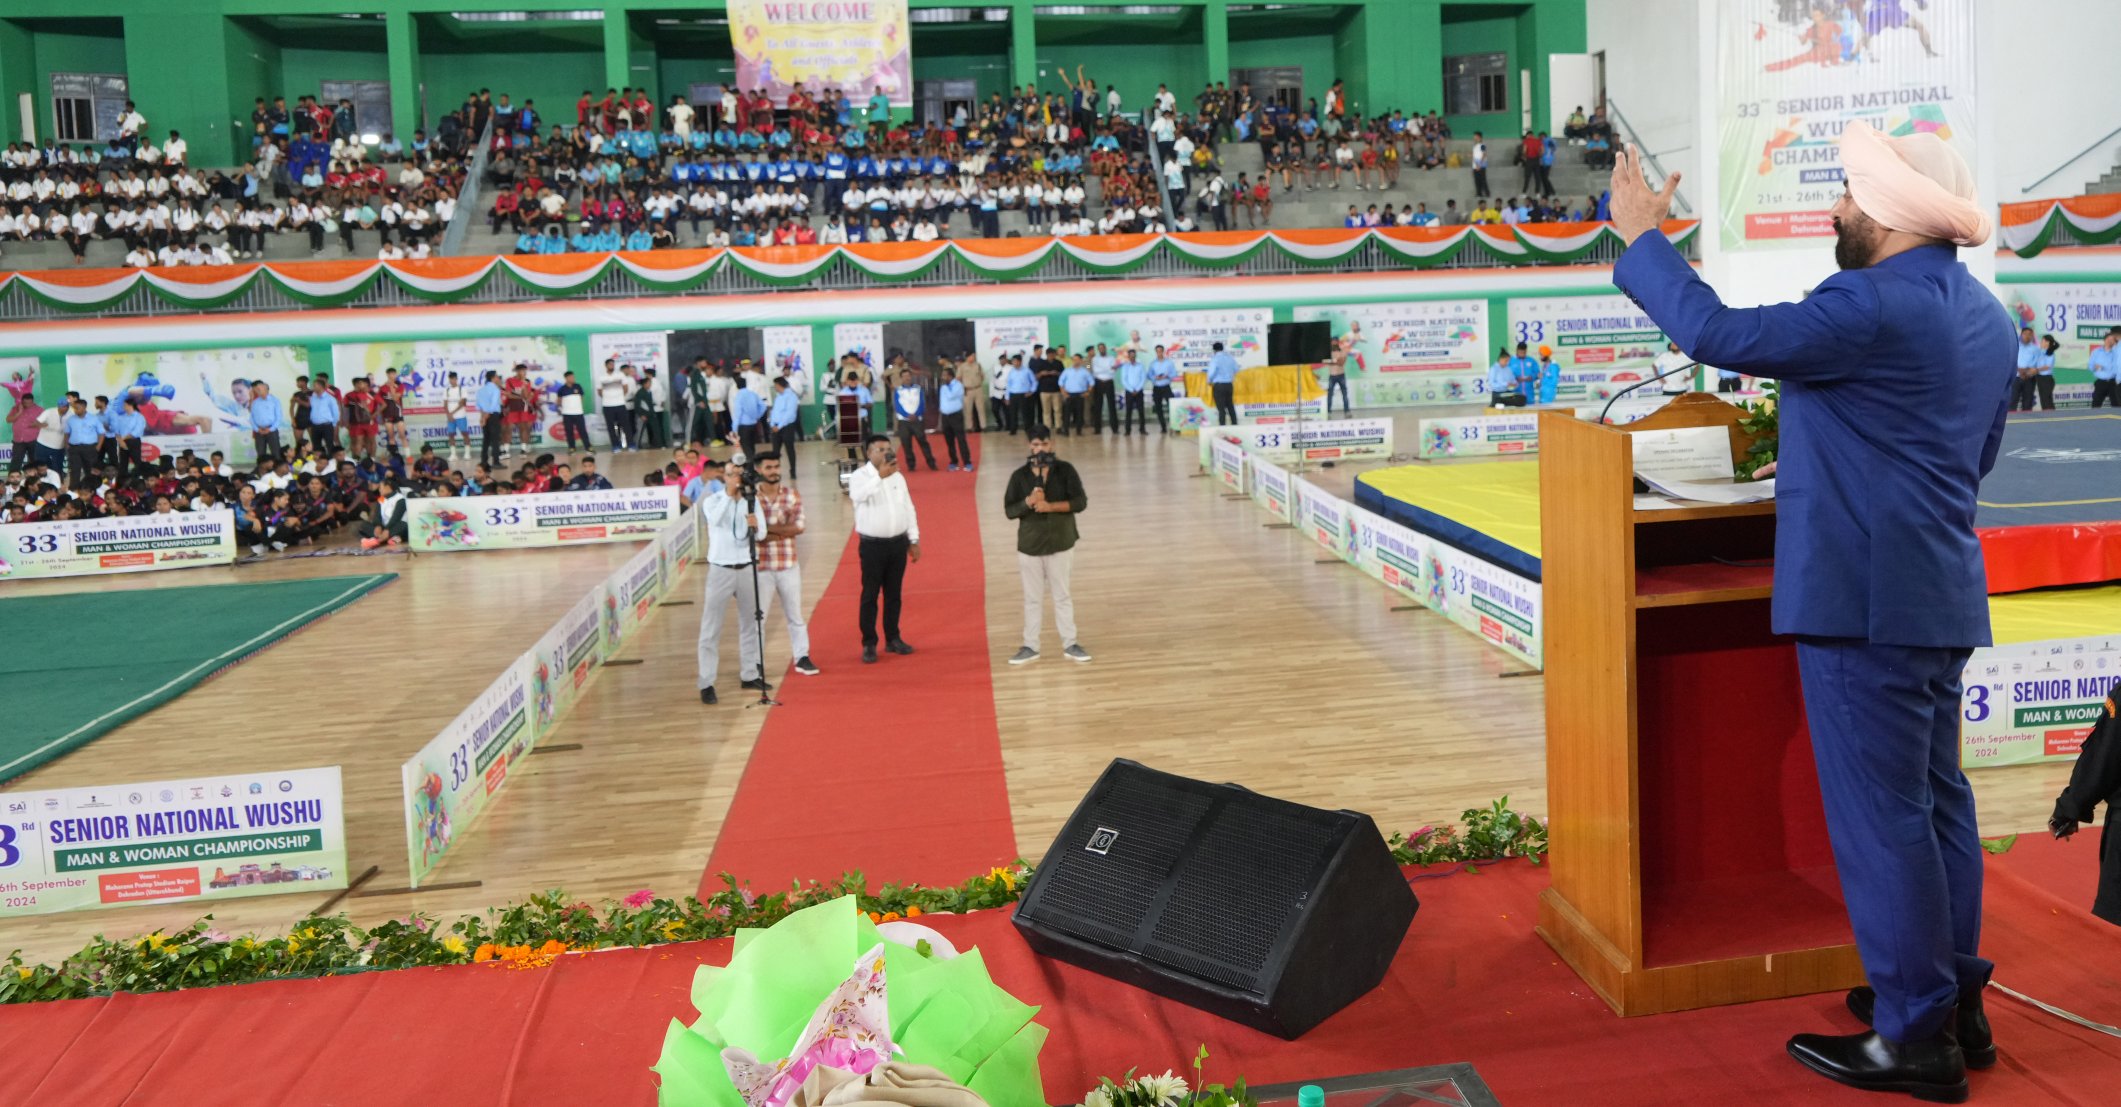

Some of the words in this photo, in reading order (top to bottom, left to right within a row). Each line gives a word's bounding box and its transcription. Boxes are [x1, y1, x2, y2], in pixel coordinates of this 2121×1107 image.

[764, 2, 875, 21] WELCOME
[1737, 102, 1760, 118] 33
[1777, 95, 1844, 115] SENIOR
[1852, 85, 1953, 108] NATIONAL
[1804, 171, 1830, 181] MAN
[1757, 194, 1783, 205] 21st
[1796, 190, 1824, 202] 26th
[2045, 303, 2067, 332] 33
[2076, 304, 2102, 320] SENIOR
[1515, 320, 1545, 343] 33
[1556, 318, 1588, 332] SENIOR
[1591, 317, 1632, 331] NATIONAL
[1255, 433, 1280, 448] 33
[1460, 426, 1478, 440] 33
[485, 507, 520, 527] 33
[535, 504, 574, 516] SENIOR
[576, 501, 628, 514] NATIONAL
[630, 499, 668, 511] WUSHU
[18, 534, 58, 554] 33
[74, 530, 118, 542] SENIOR
[121, 526, 177, 540] NATIONAL
[180, 523, 222, 536] WUSHU
[82, 545, 104, 553] MAN
[113, 543, 149, 552] WOMAN
[151, 537, 216, 549] CHAMPIONSHIP
[1451, 566, 1465, 595] 33
[1964, 685, 1990, 722] 3
[2013, 679, 2071, 703] SENIOR
[2023, 710, 2050, 723] MAN
[2054, 709, 2062, 721] &
[1966, 734, 1986, 745] 26th
[1988, 732, 2036, 744] September
[1975, 748, 1998, 758] 2024
[450, 743, 468, 792] 33
[9, 801, 26, 812] SAI
[21, 822, 35, 831] Rd
[50, 815, 130, 844] SENIOR
[136, 806, 240, 837] NATIONAL
[244, 799, 322, 828] WUSHU
[66, 852, 105, 867] MAN
[109, 851, 120, 863] &
[124, 845, 190, 862] WOMAN
[193, 834, 312, 857] CHAMPIONSHIP
[22, 877, 87, 892] September
[6, 896, 37, 908] 2024
